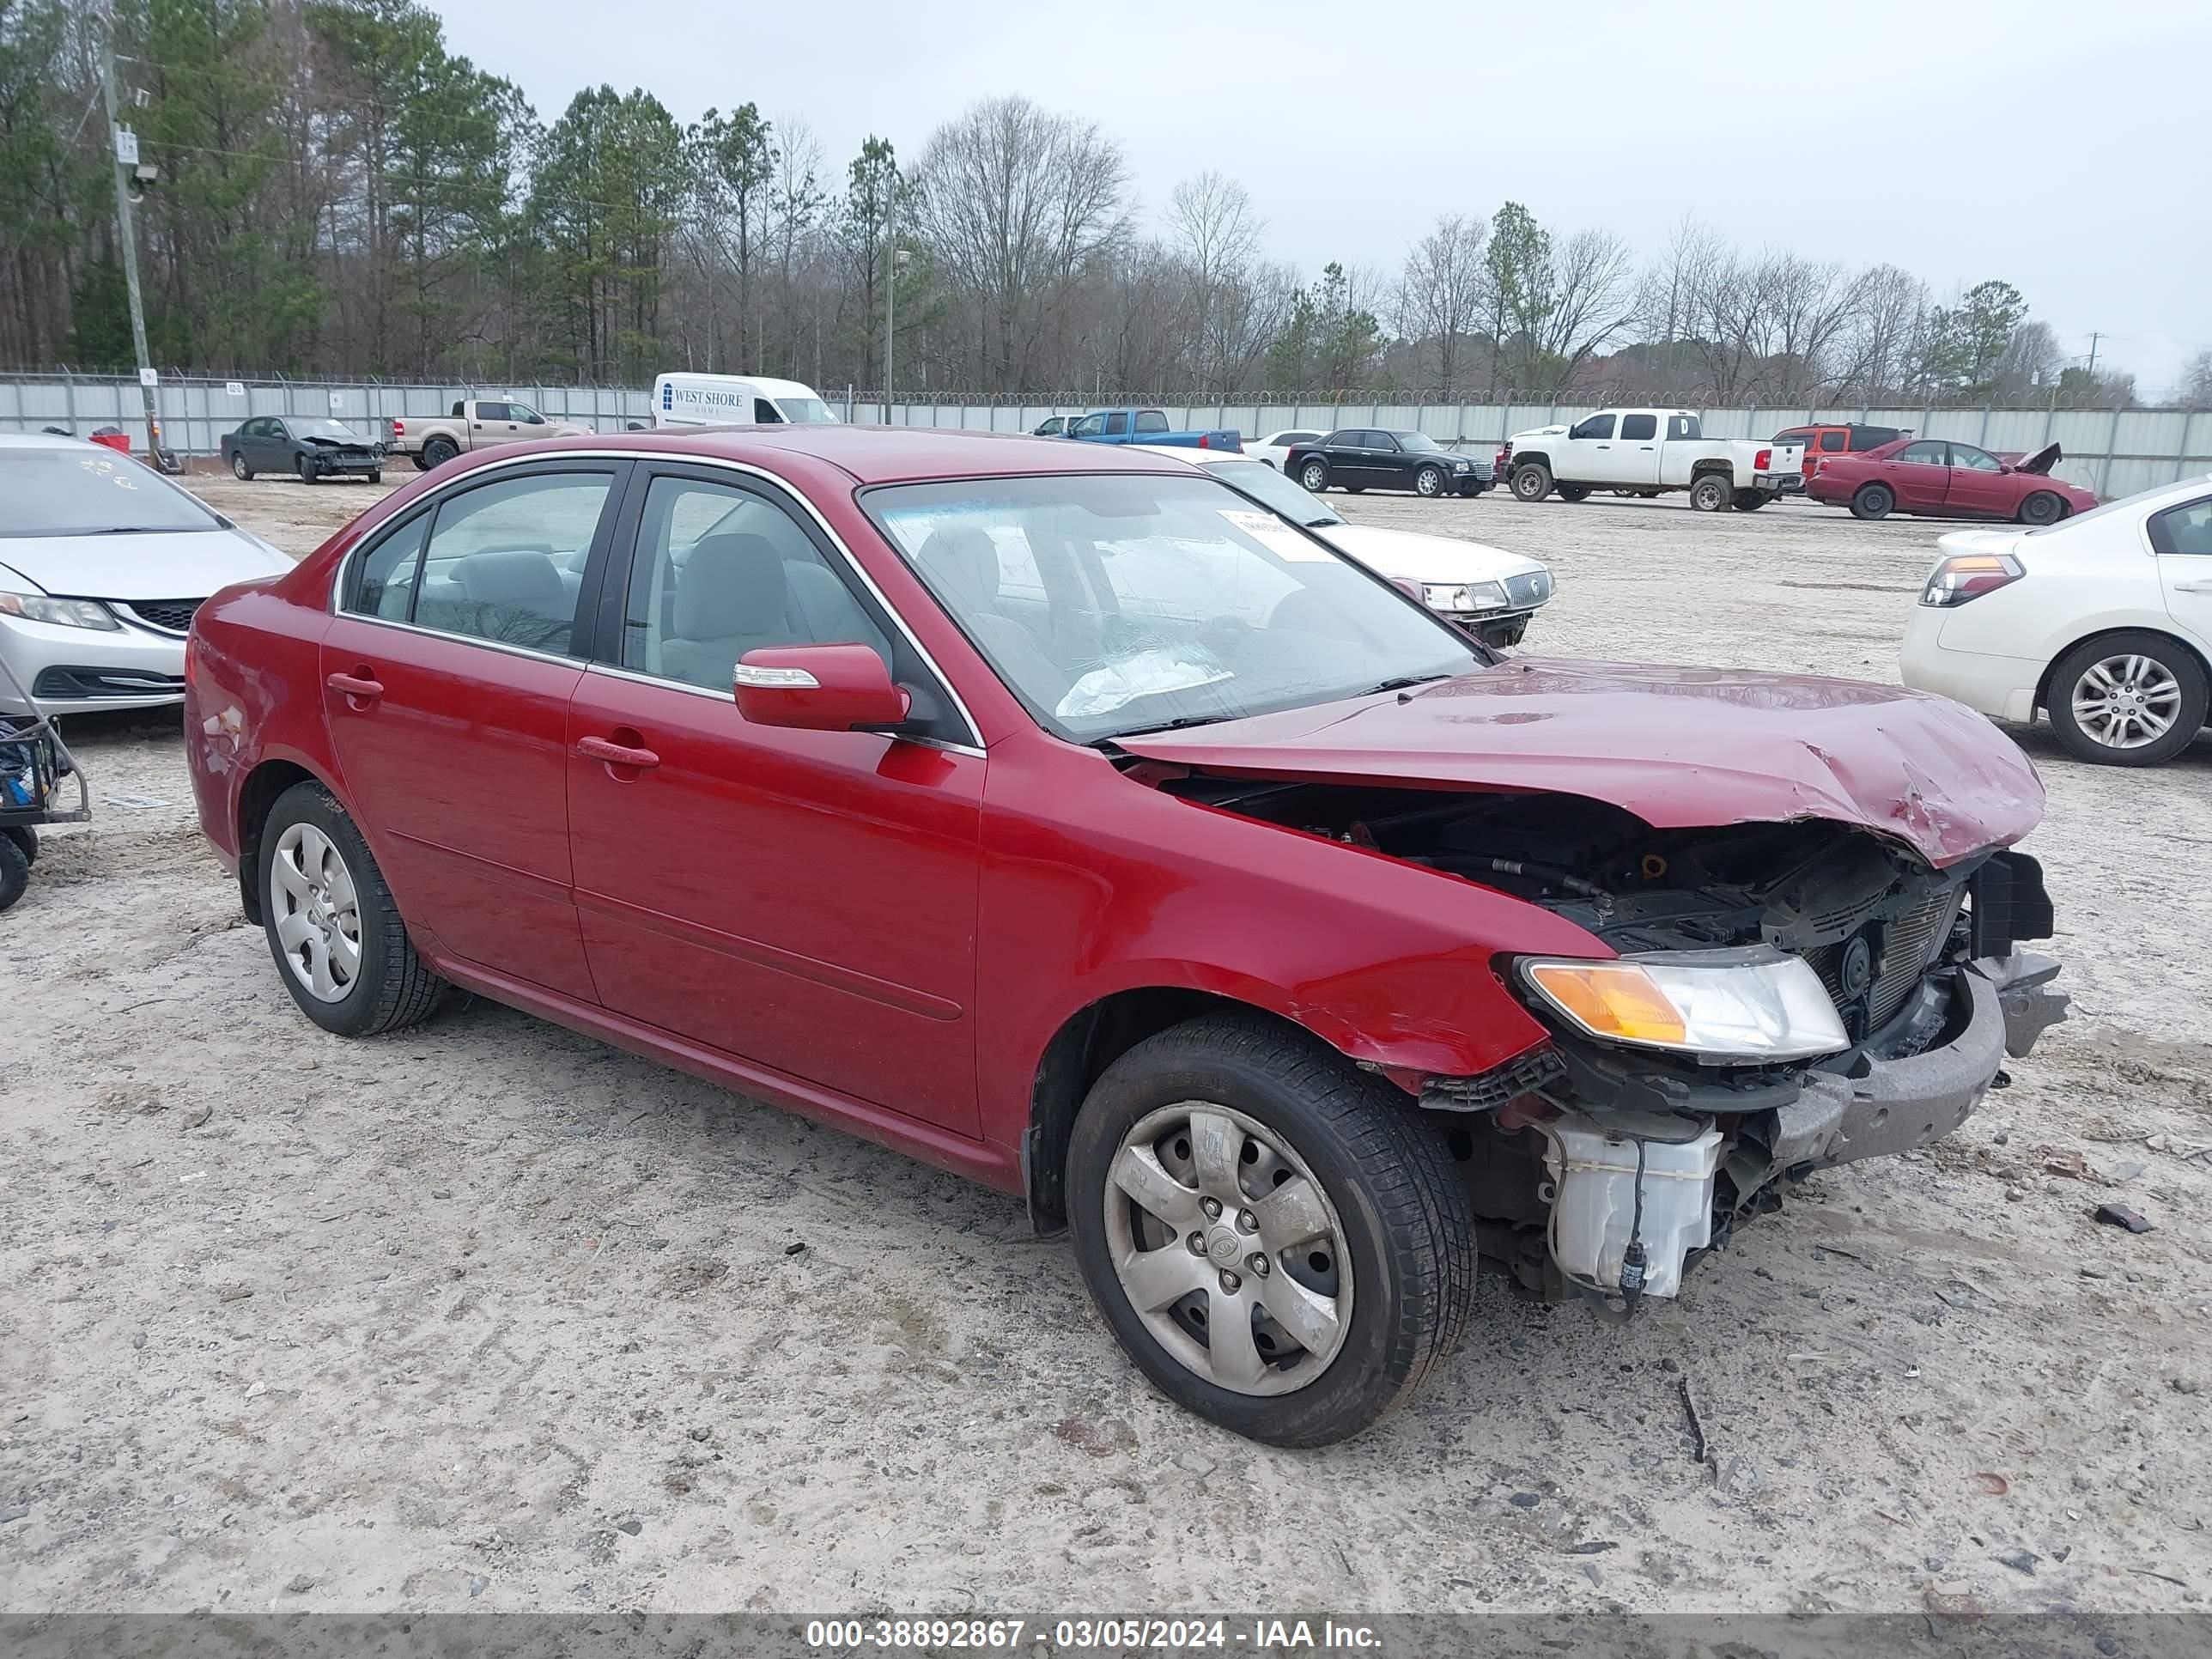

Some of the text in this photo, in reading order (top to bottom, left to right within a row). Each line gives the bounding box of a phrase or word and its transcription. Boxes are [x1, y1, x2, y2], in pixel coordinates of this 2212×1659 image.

[675, 389, 743, 407] WEST SHORE
[1680, 418, 1689, 434] D
